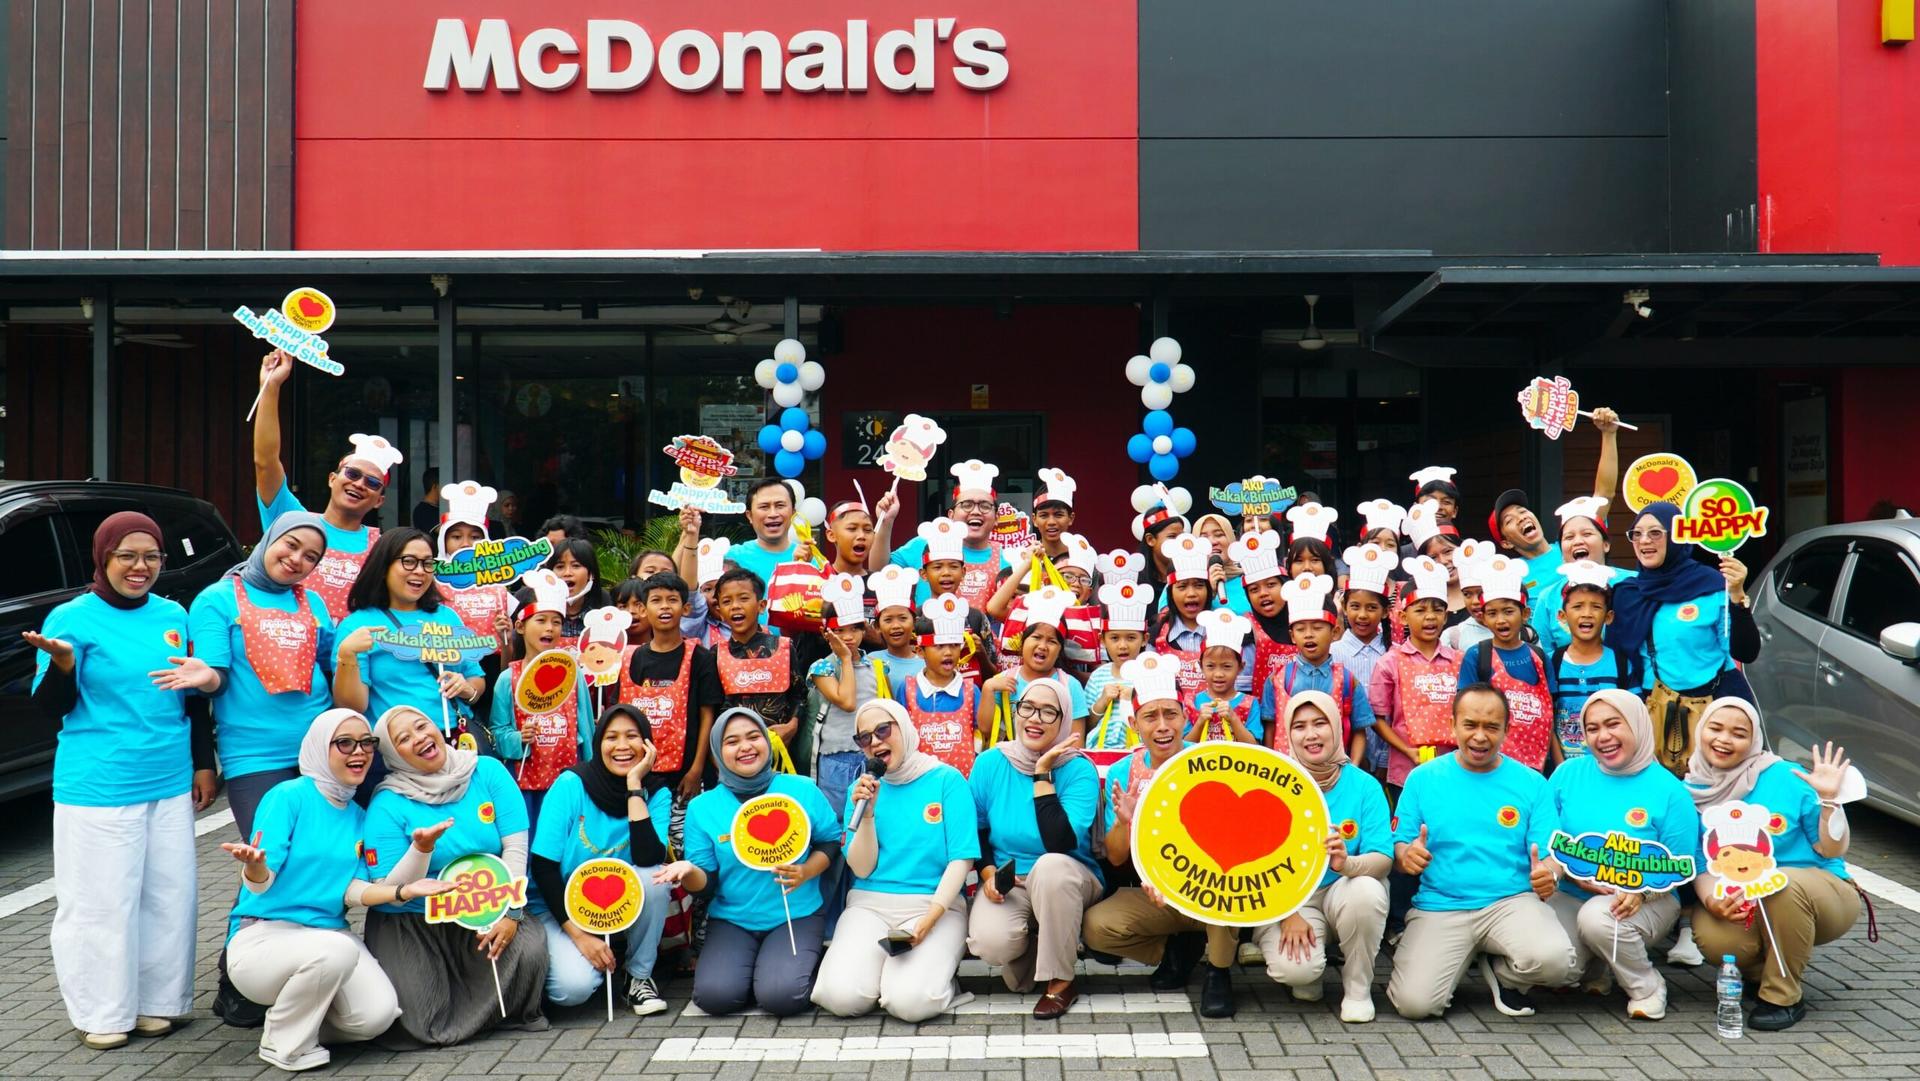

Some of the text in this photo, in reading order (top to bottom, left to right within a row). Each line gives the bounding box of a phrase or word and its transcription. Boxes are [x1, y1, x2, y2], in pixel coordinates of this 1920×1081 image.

[422, 18, 1010, 92] McDonald's
[266, 311, 327, 351] Happy to
[237, 309, 344, 374] Help and Share
[1542, 386, 1559, 426] Happy
[1549, 378, 1571, 438] Birthday
[1562, 392, 1576, 428] McD
[665, 447, 736, 475] Birthday
[679, 447, 724, 465] Happy
[1635, 459, 1680, 473] McDonald's
[680, 461, 722, 477] McD
[1210, 486, 1297, 504] Kakak Bimbing
[1242, 478, 1264, 492] Aku
[998, 507, 1013, 516] 35
[1242, 502, 1271, 516] McD
[1700, 496, 1737, 519] SO
[1676, 509, 1764, 539] HAPPY
[988, 529, 1026, 545] Happy
[432, 538, 552, 576] Kakak Bimbing
[474, 540, 505, 558] Aku
[475, 565, 516, 587] McD
[421, 622, 453, 636] Aku
[377, 630, 498, 650] Kakak Bimbing
[421, 649, 462, 663] McD
[539, 655, 573, 668] McDonald's
[597, 672, 618, 685] Mc
[524, 688, 564, 704] COMMUNITY
[527, 701, 553, 710] MONTH
[1429, 693, 1450, 703] Tour
[537, 735, 558, 745] Tour
[931, 741, 953, 750] Tour
[1187, 755, 1305, 797] McDonald's
[743, 800, 789, 818] McDonald's
[747, 830, 800, 857] COMMUNITY
[1603, 833, 1641, 855] Aku
[760, 847, 795, 864] MONTH
[1552, 833, 1693, 877] Kakak Bimbing
[580, 866, 628, 877] McDonald's
[1159, 842, 1297, 894] COMMUNITY
[1595, 864, 1644, 888] McD
[456, 869, 495, 892] SO
[1745, 875, 1786, 896] McD
[430, 880, 523, 918] HAPPY
[1178, 879, 1267, 913] MONTH
[578, 898, 633, 920] COMMUNITY
[589, 916, 624, 929] MONTH
